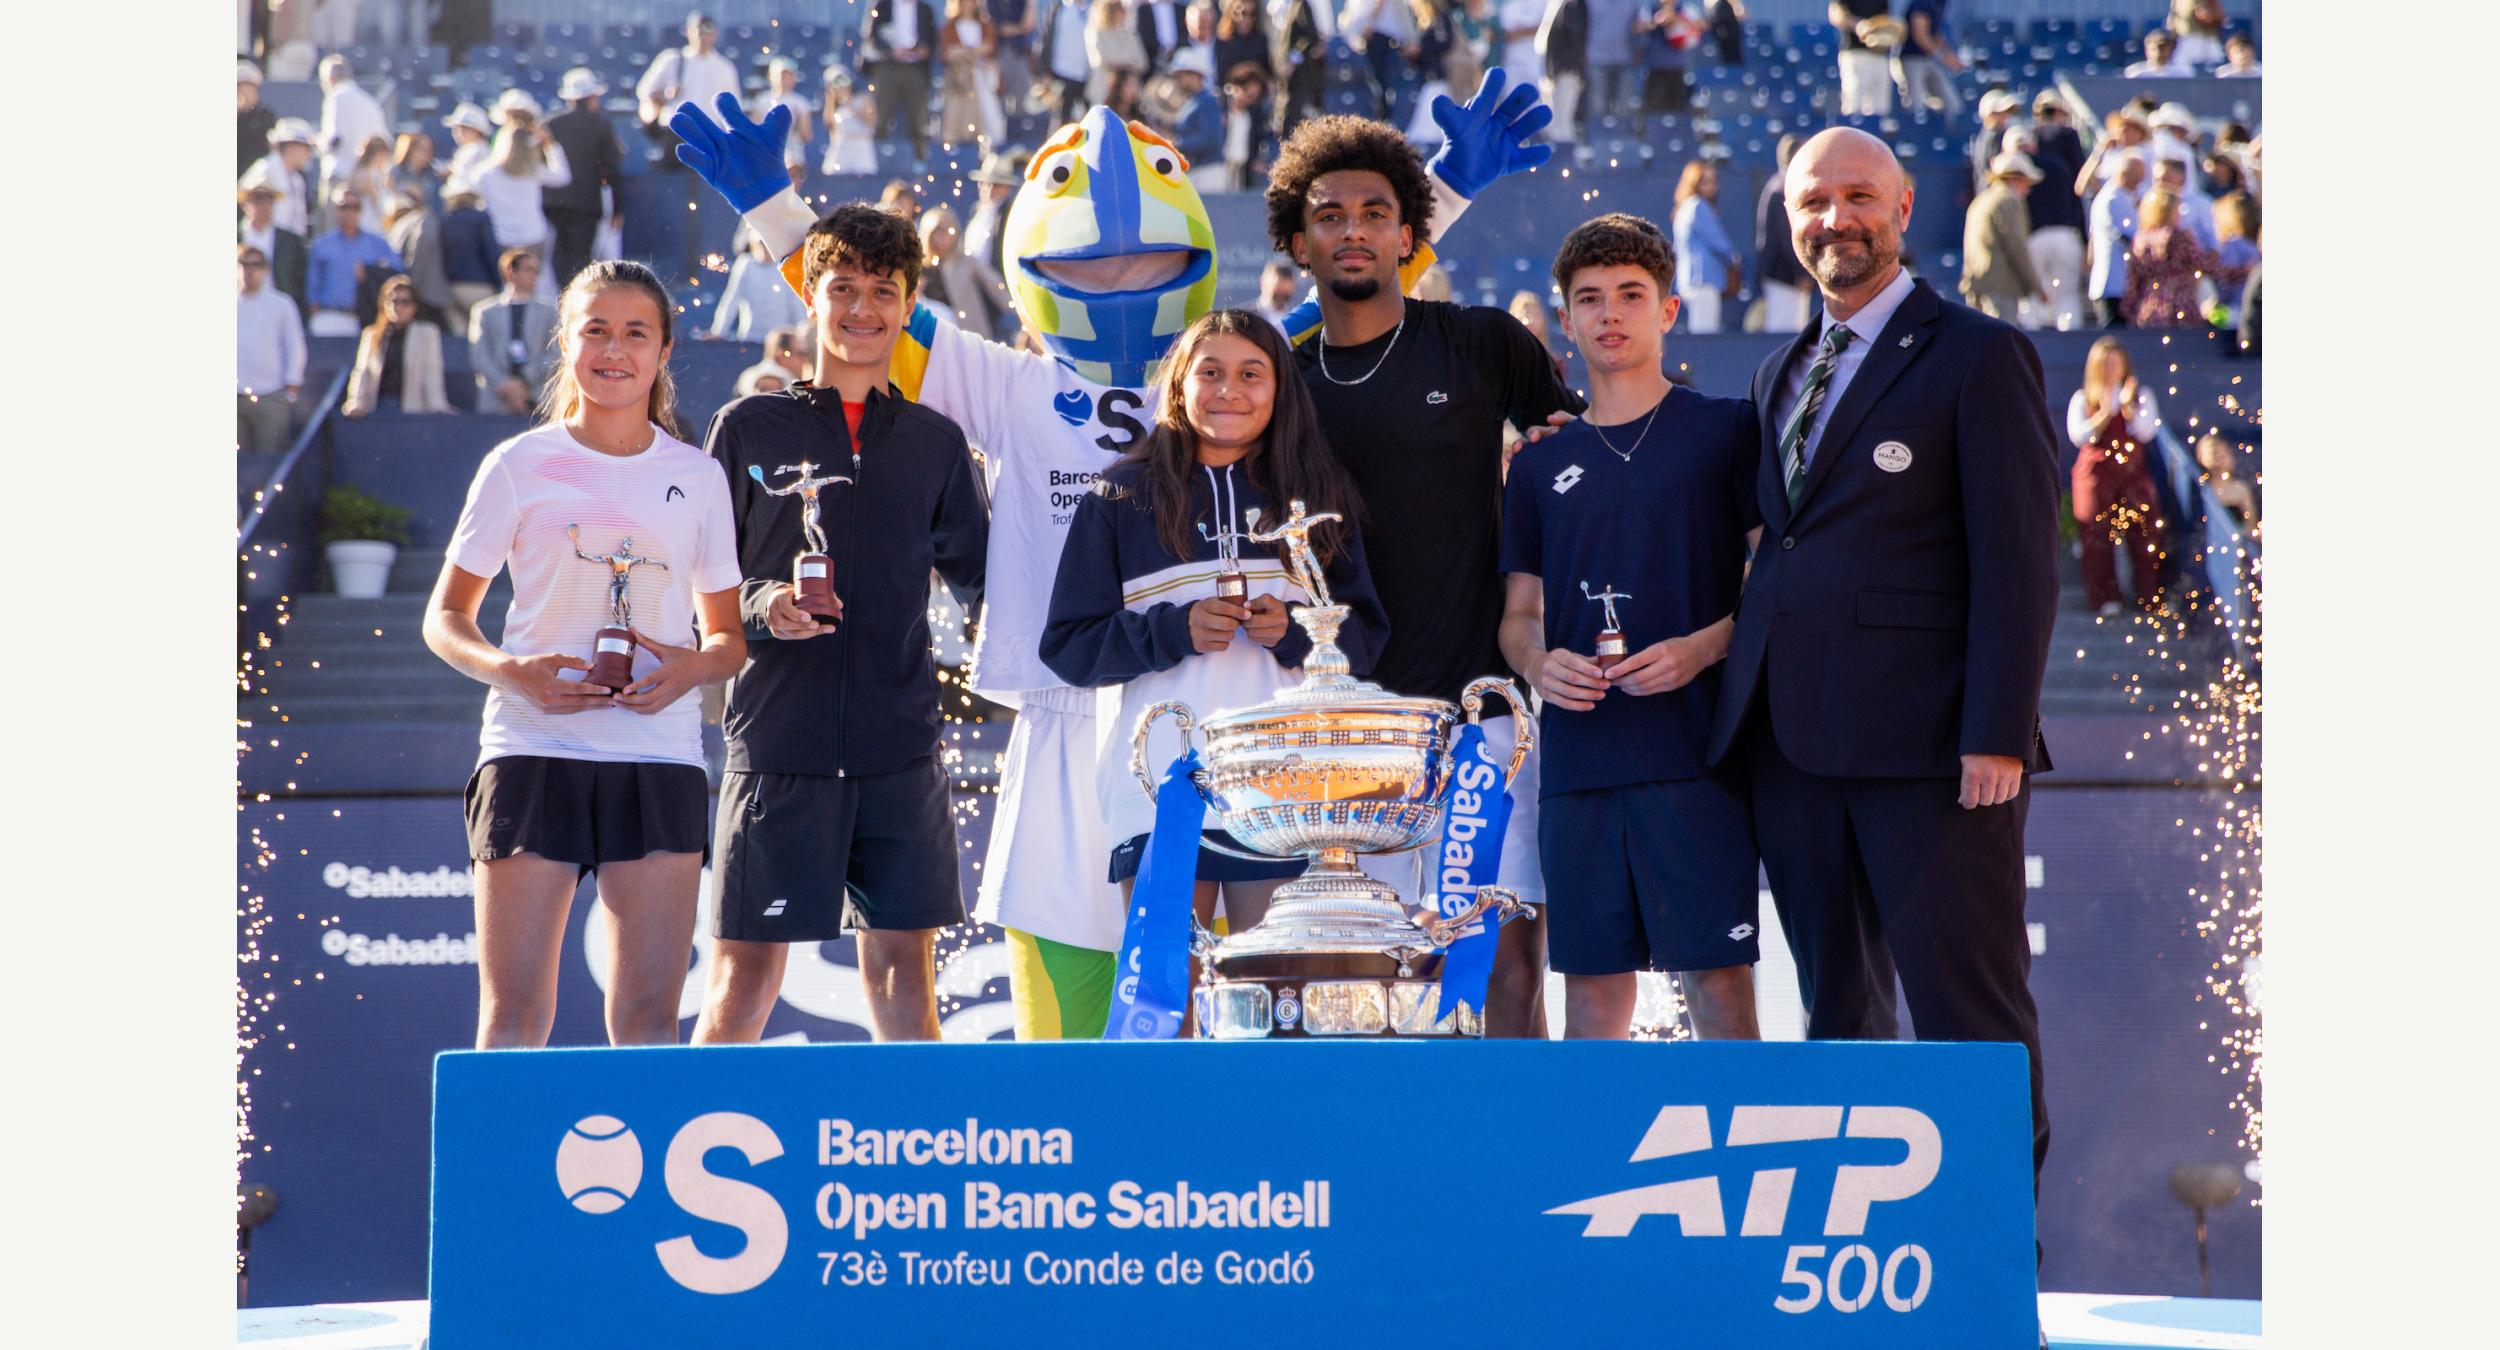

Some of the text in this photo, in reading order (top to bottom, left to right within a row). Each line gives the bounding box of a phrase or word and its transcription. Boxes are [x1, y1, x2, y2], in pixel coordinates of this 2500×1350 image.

[1095, 389, 1147, 454] S
[1877, 452, 1907, 463] MANGO
[1050, 470, 1101, 486] Barce
[1050, 492, 1083, 509] Ope
[1052, 514, 1073, 525] Trof
[345, 865, 475, 898] Sabadel
[344, 932, 477, 966] Sabadel
[818, 1118, 1073, 1167] Barcelona
[1541, 1105, 1943, 1238] ATP
[656, 1112, 788, 1294] S
[816, 1181, 1330, 1240] Open Banc Sabadell
[817, 1250, 1314, 1286] 73è Trofeu Conde de Godó
[1774, 1244, 1932, 1314] 500
